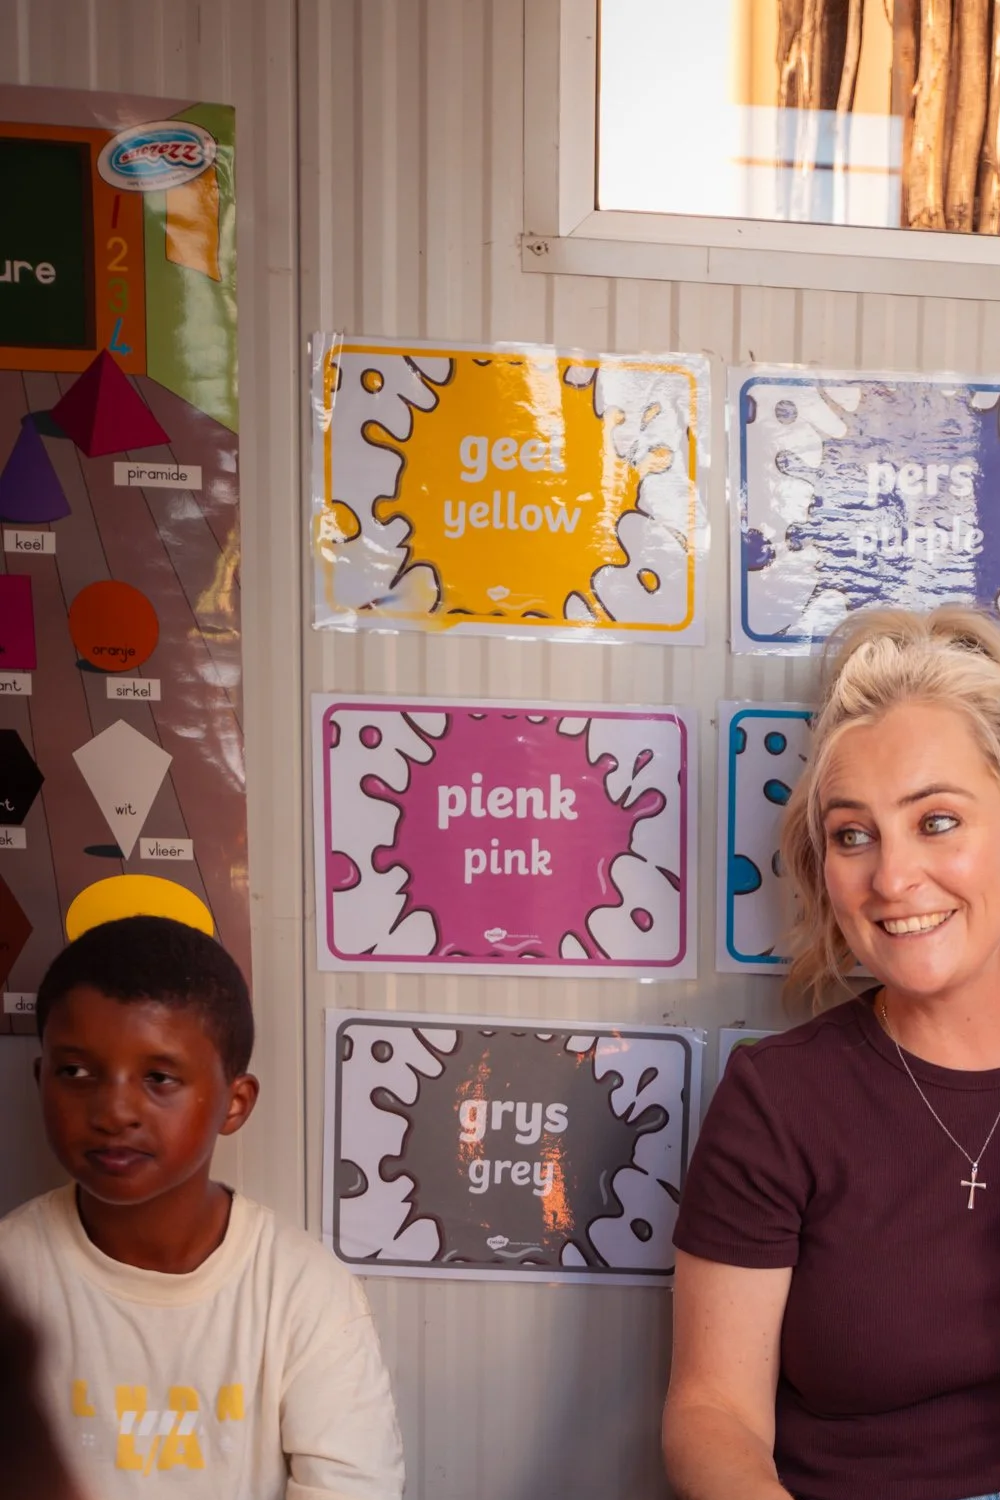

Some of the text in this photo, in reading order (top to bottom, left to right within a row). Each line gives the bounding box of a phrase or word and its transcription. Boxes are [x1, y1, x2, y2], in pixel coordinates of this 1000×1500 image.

[111, 195, 120, 229] 1
[107, 237, 128, 272] 2
[108, 278, 129, 314] 3
[109, 317, 133, 356] 4
[127, 465, 188, 486] piramide
[459, 435, 567, 483] geel
[867, 462, 976, 506] pers
[444, 490, 582, 539] yellow
[15, 532, 44, 551] keël
[855, 516, 985, 562] purple
[92, 645, 136, 663] oranje
[116, 681, 151, 697] sirkel
[115, 803, 137, 816] wit
[437, 772, 578, 829] pienk
[464, 838, 553, 884] pink
[459, 1099, 569, 1145] grys
[468, 1160, 554, 1197] grey
